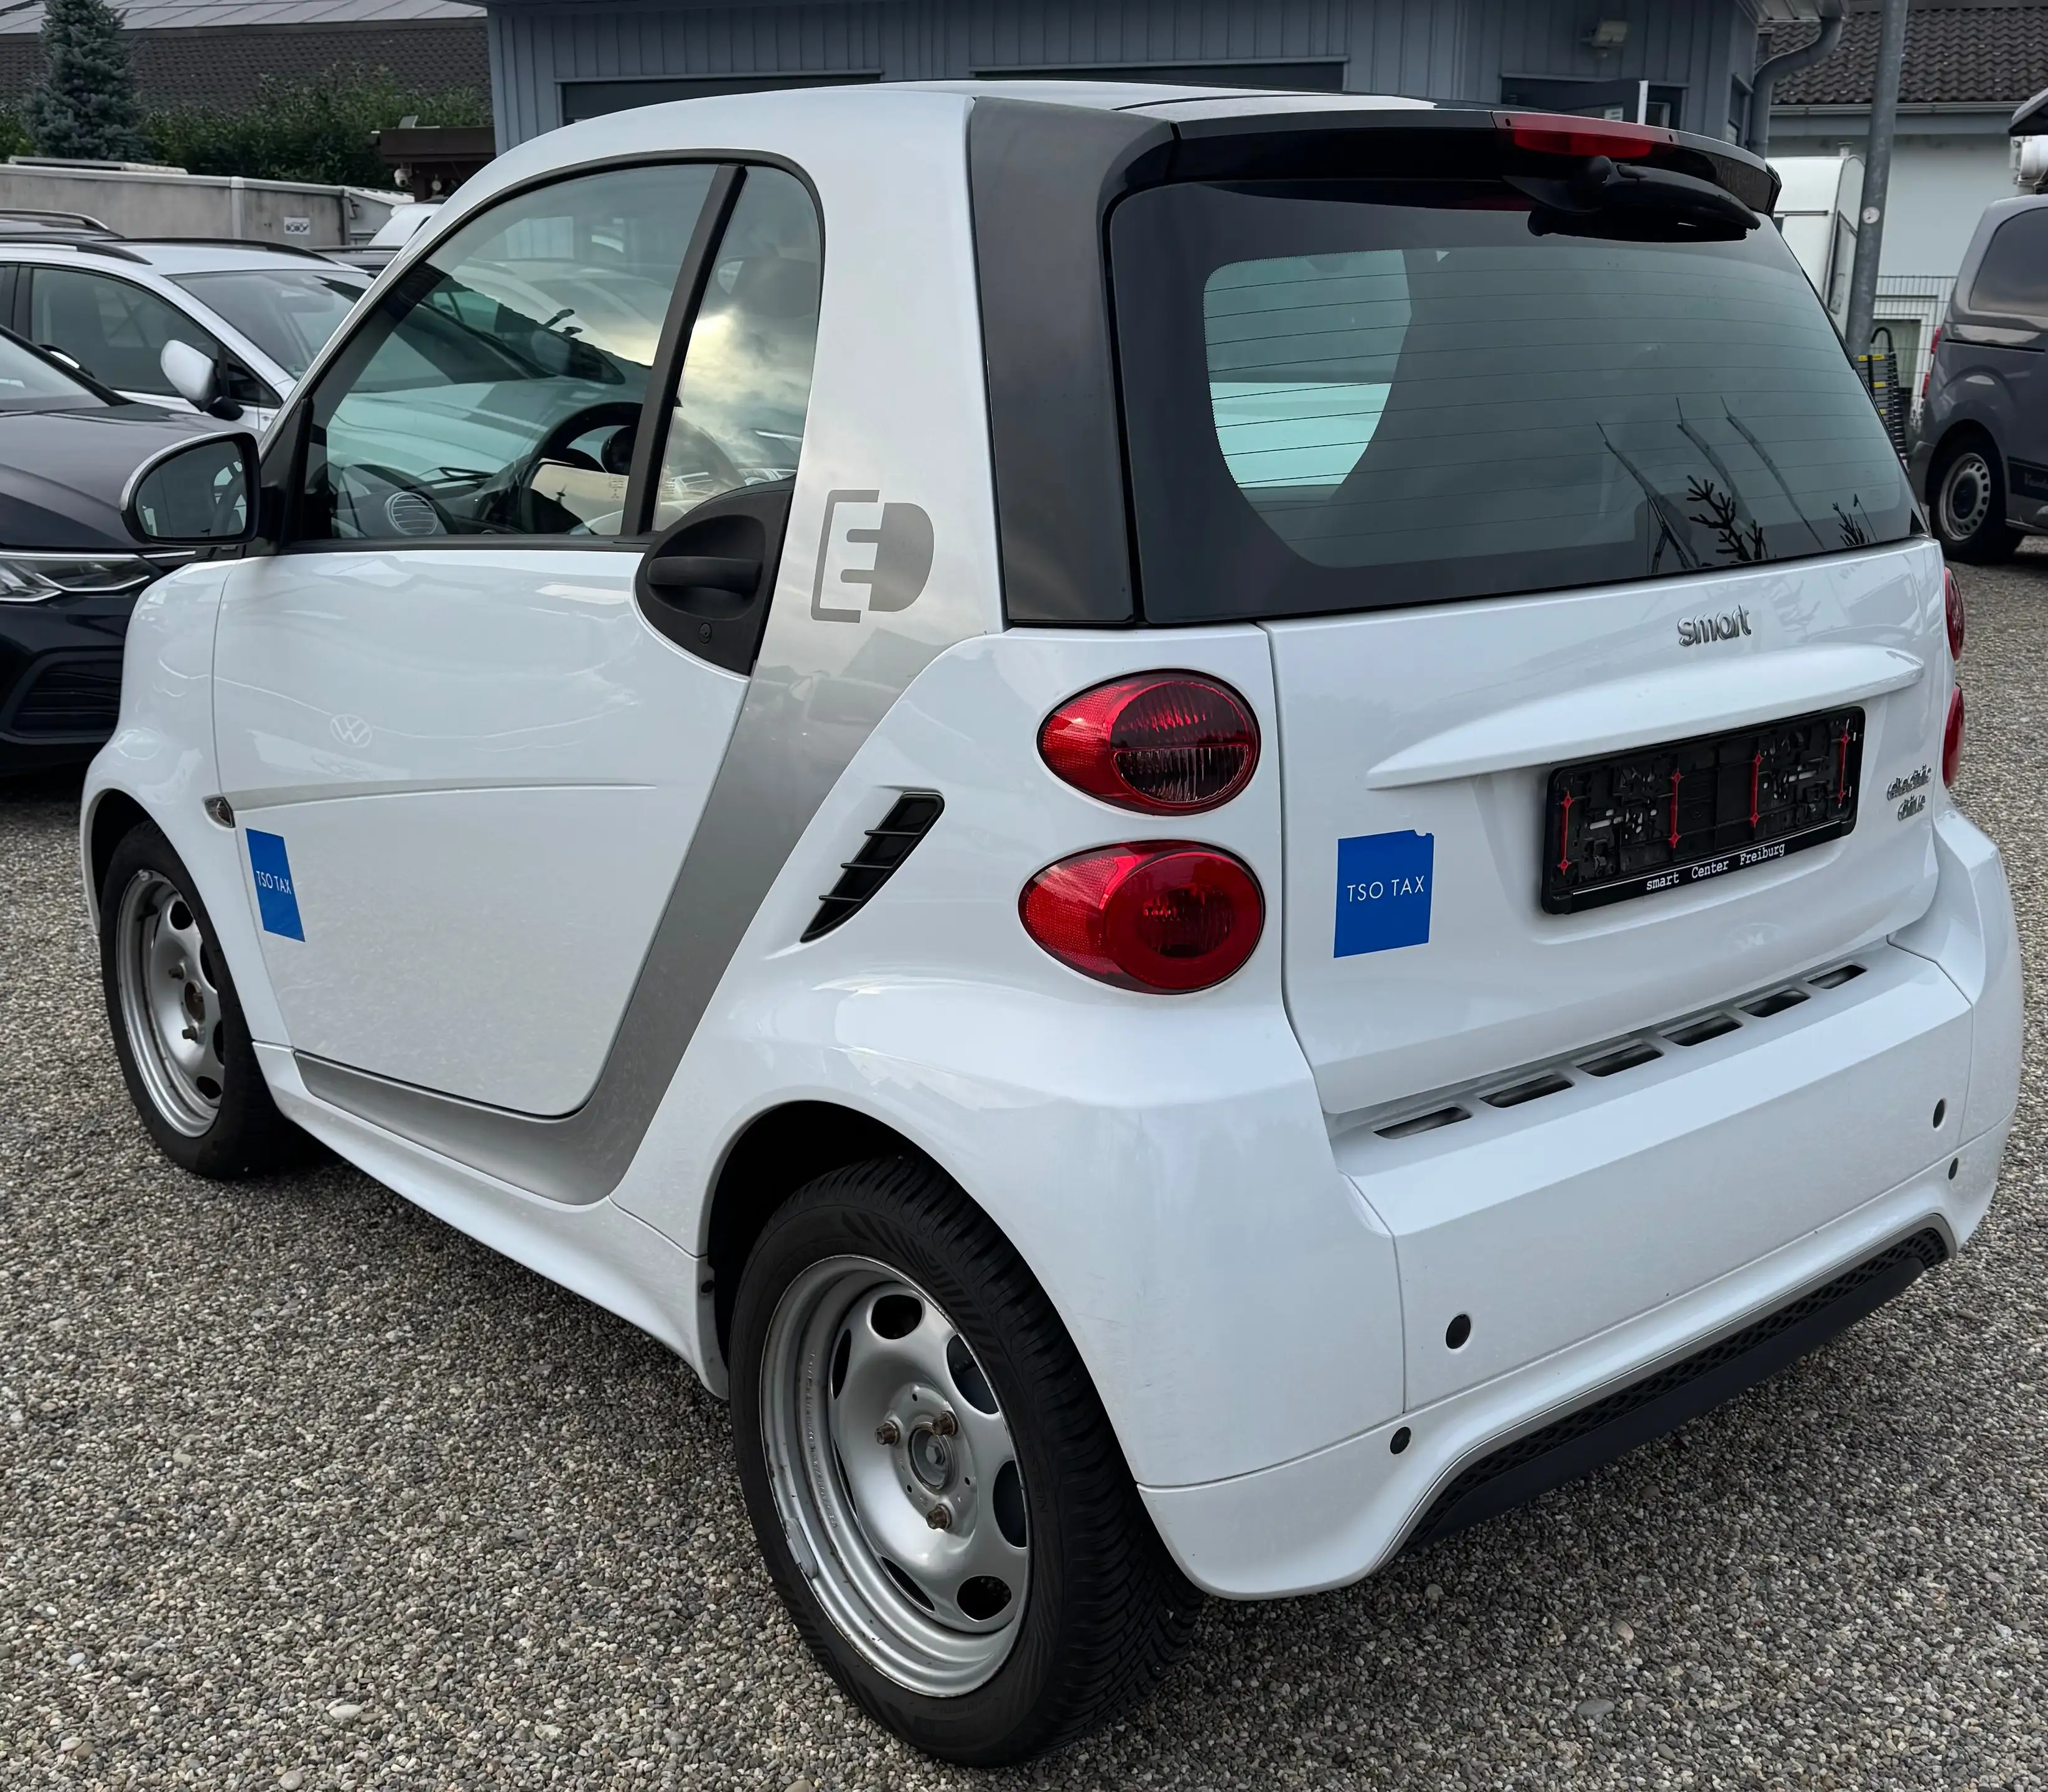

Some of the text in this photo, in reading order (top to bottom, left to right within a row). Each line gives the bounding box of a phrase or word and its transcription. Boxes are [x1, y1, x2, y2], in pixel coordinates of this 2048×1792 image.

[1677, 604, 1752, 647] smart
[256, 870, 292, 894] TSO TAX
[1646, 844, 1785, 890] smart Center Freiburg
[1347, 875, 1424, 902] TSO TAX
